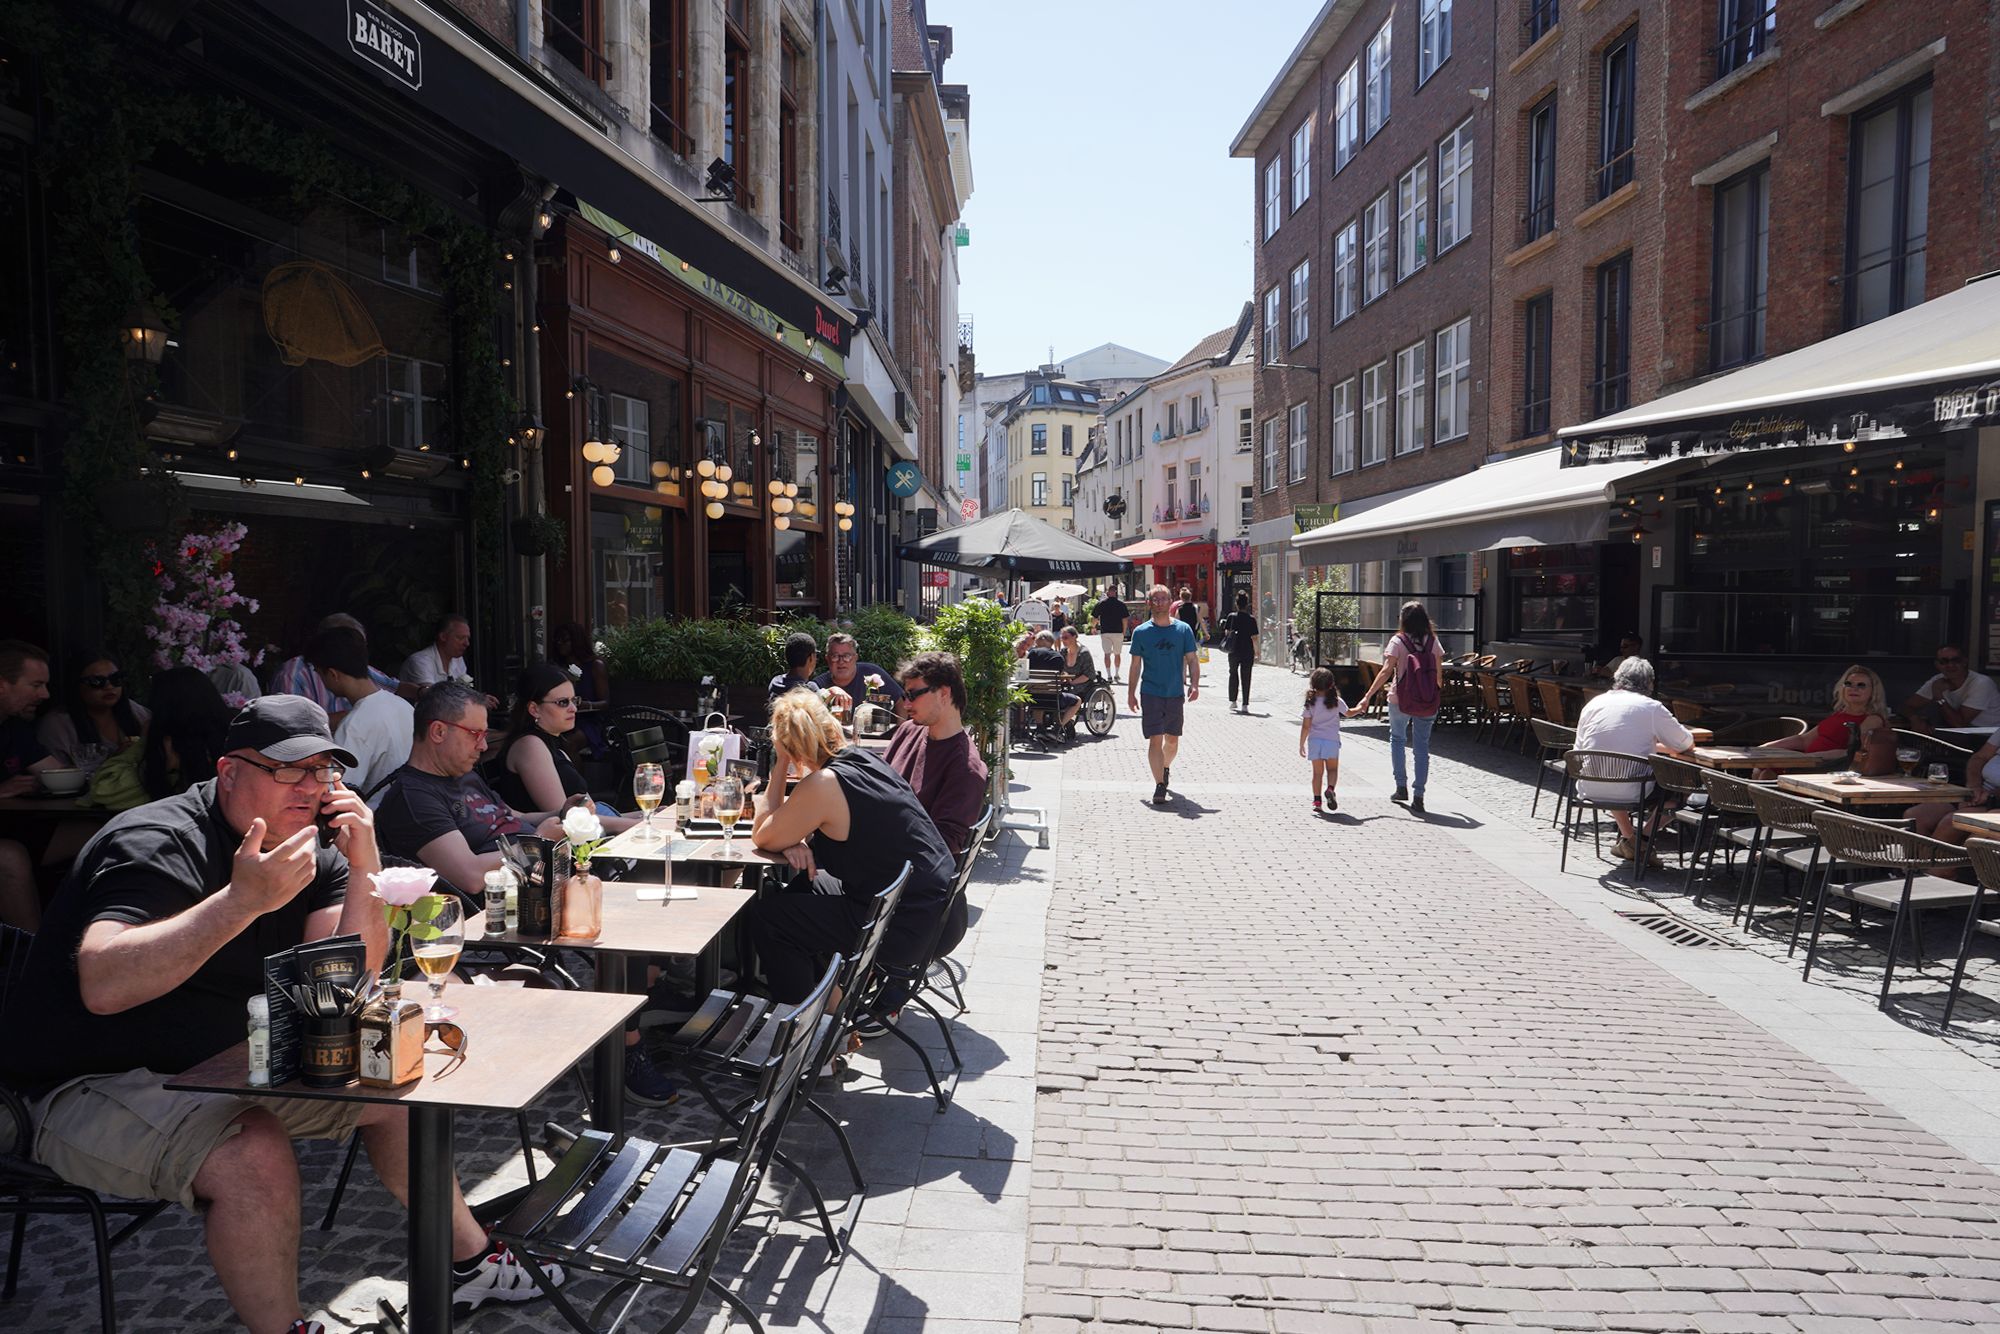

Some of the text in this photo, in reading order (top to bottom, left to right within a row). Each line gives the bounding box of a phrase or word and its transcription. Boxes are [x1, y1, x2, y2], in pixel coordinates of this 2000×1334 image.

[355, 12, 415, 78] BARET
[815, 304, 840, 346] Duvel
[1931, 390, 1979, 422] TRIPEL
[1298, 518, 1309, 526] TE
[1048, 560, 1081, 571] WASBAR
[1768, 681, 1833, 704] Duvel
[314, 962, 354, 978] BARET
